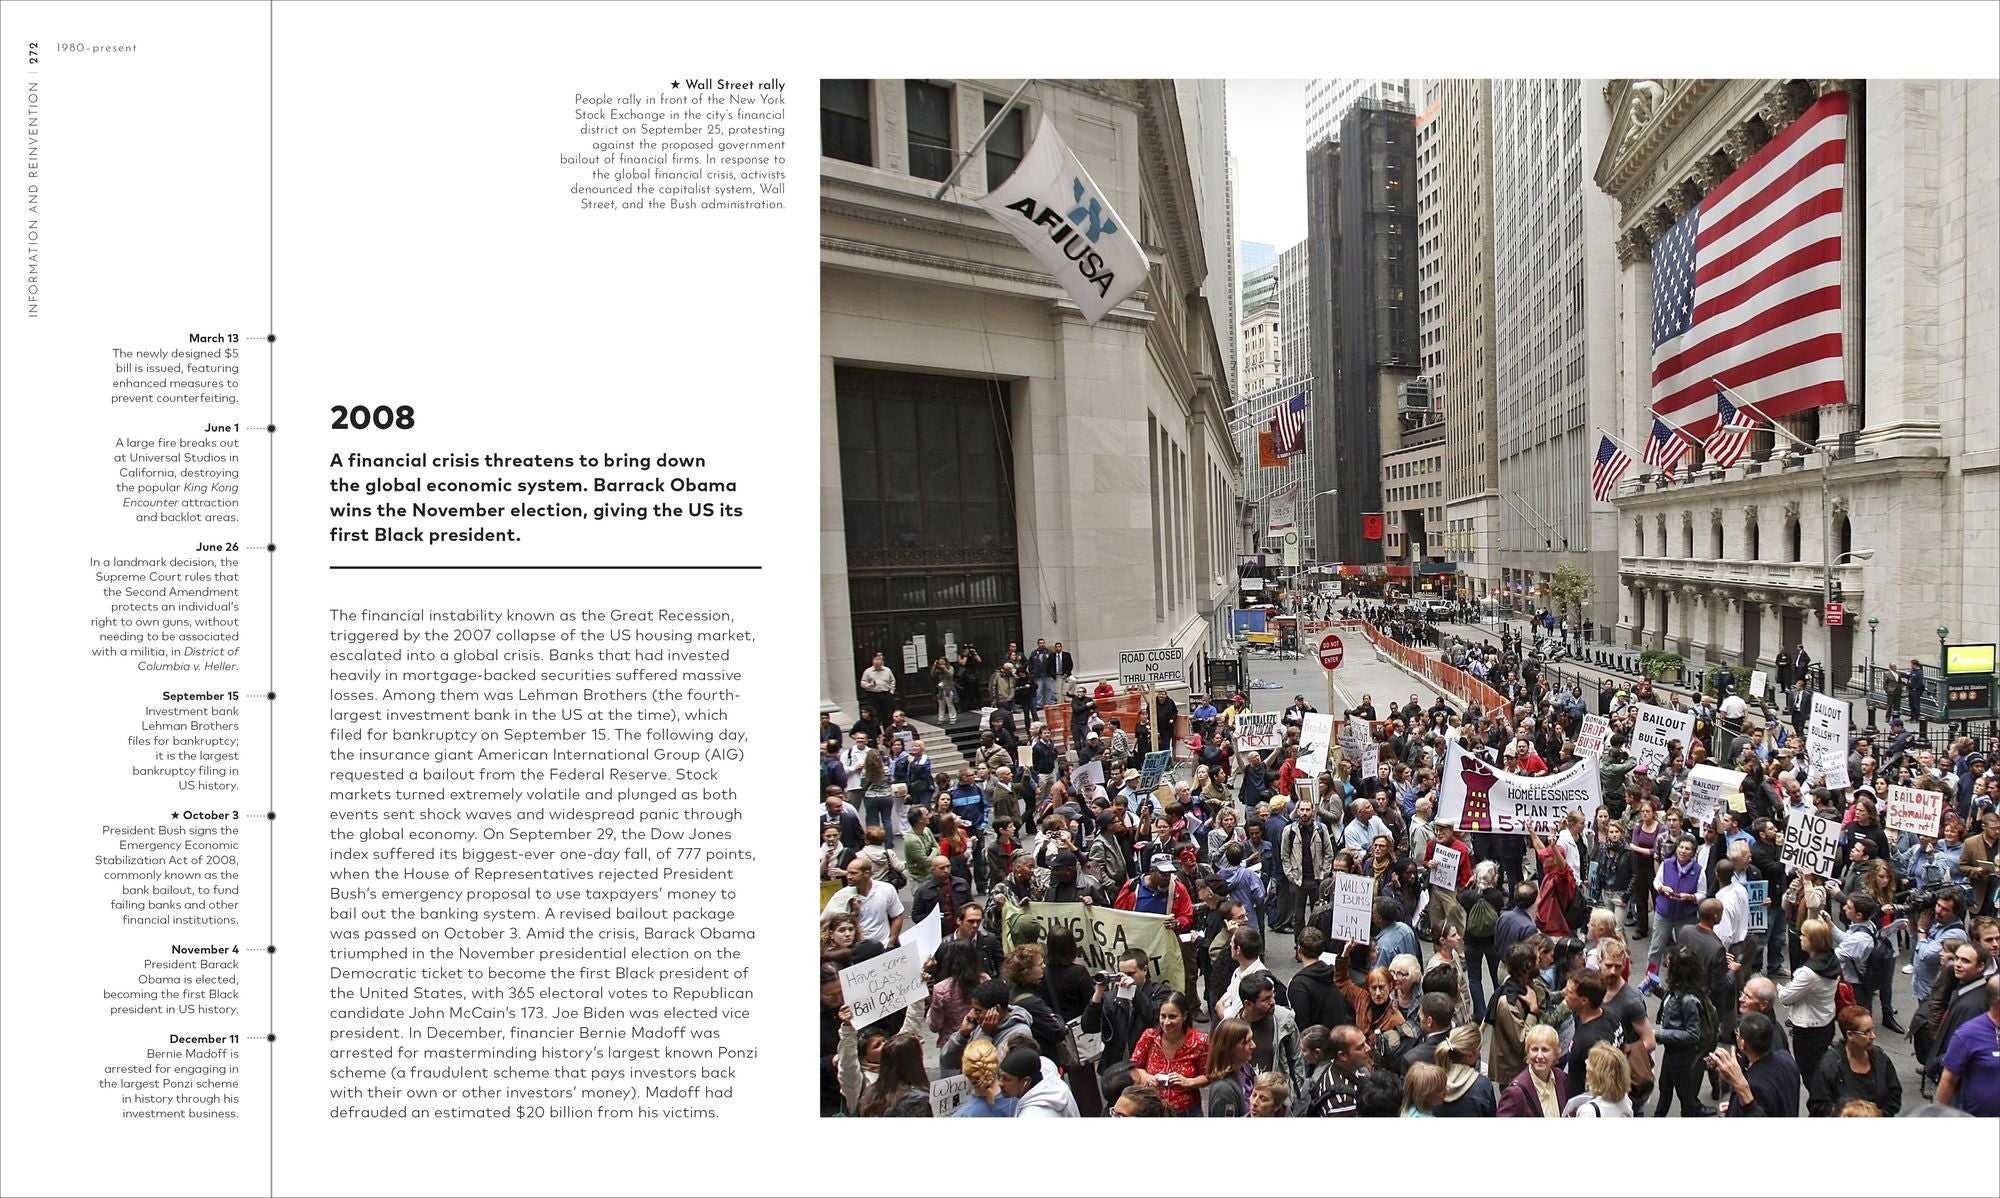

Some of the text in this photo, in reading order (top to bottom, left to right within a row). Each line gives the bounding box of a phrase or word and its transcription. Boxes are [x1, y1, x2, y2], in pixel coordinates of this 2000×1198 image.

[686, 78, 785, 92] Wall Street rally
[576, 93, 784, 106] People rally in front of the New York
[28, 43, 38, 317] INFORMATION AND REINVENTION 272
[582, 198, 785, 210] Street, and the Bush administration.
[190, 333, 239, 343] March 13
[116, 363, 238, 374] bill is issued, featuring
[331, 405, 415, 430] 2008
[205, 423, 238, 432] June 1
[330, 453, 705, 470] A financial crisis threatens to bring down
[330, 477, 736, 495] the global economic system. Barrack Obama
[330, 502, 742, 520] wins the November election, giving the US its
[330, 527, 520, 545] first Black president.
[196, 542, 239, 551] June 26
[330, 609, 734, 623] The financial instability known as the Great Recession,
[1121, 650, 1181, 663] ROAD CLOSED
[1324, 656, 1339, 664] ENTER
[1145, 662, 1159, 671] NO
[1123, 670, 1181, 683] THRU TRAFFIC
[163, 691, 239, 702] September 15
[1815, 702, 1842, 720] BAILOUT
[142, 721, 239, 730] Lehman Brothers
[1585, 715, 1607, 726] BOMBS
[1643, 712, 1686, 731] BAILOUT
[1582, 723, 1605, 736] DROP
[1242, 735, 1274, 747] NEXT
[1578, 736, 1601, 751] BUSH
[1638, 733, 1670, 748] BULLSH
[1693, 780, 1720, 791] BAILOUT
[1508, 788, 1589, 800] HOMELESSNESS
[1895, 791, 1940, 808] BAILOUT
[185, 810, 239, 820] October 3
[1515, 803, 1547, 817] PLAN
[1552, 806, 1568, 818] IS
[1801, 814, 1827, 835] NO
[1786, 826, 1837, 855] BUSH
[1436, 847, 1458, 860] BAILOUT
[1340, 878, 1370, 895] WALL ST
[1342, 894, 1371, 907] BUMS
[1345, 914, 1358, 925] IN
[1036, 916, 1128, 950] SING IS A
[1337, 925, 1367, 942] JAIL
[172, 945, 239, 954] November 4
[846, 968, 877, 988] Have
[854, 996, 875, 1016] Bail
[879, 990, 895, 1005] Out
[170, 1034, 238, 1043] December 11
[330, 1105, 718, 1119] defrauded an estimated $20 billion from his victims.
